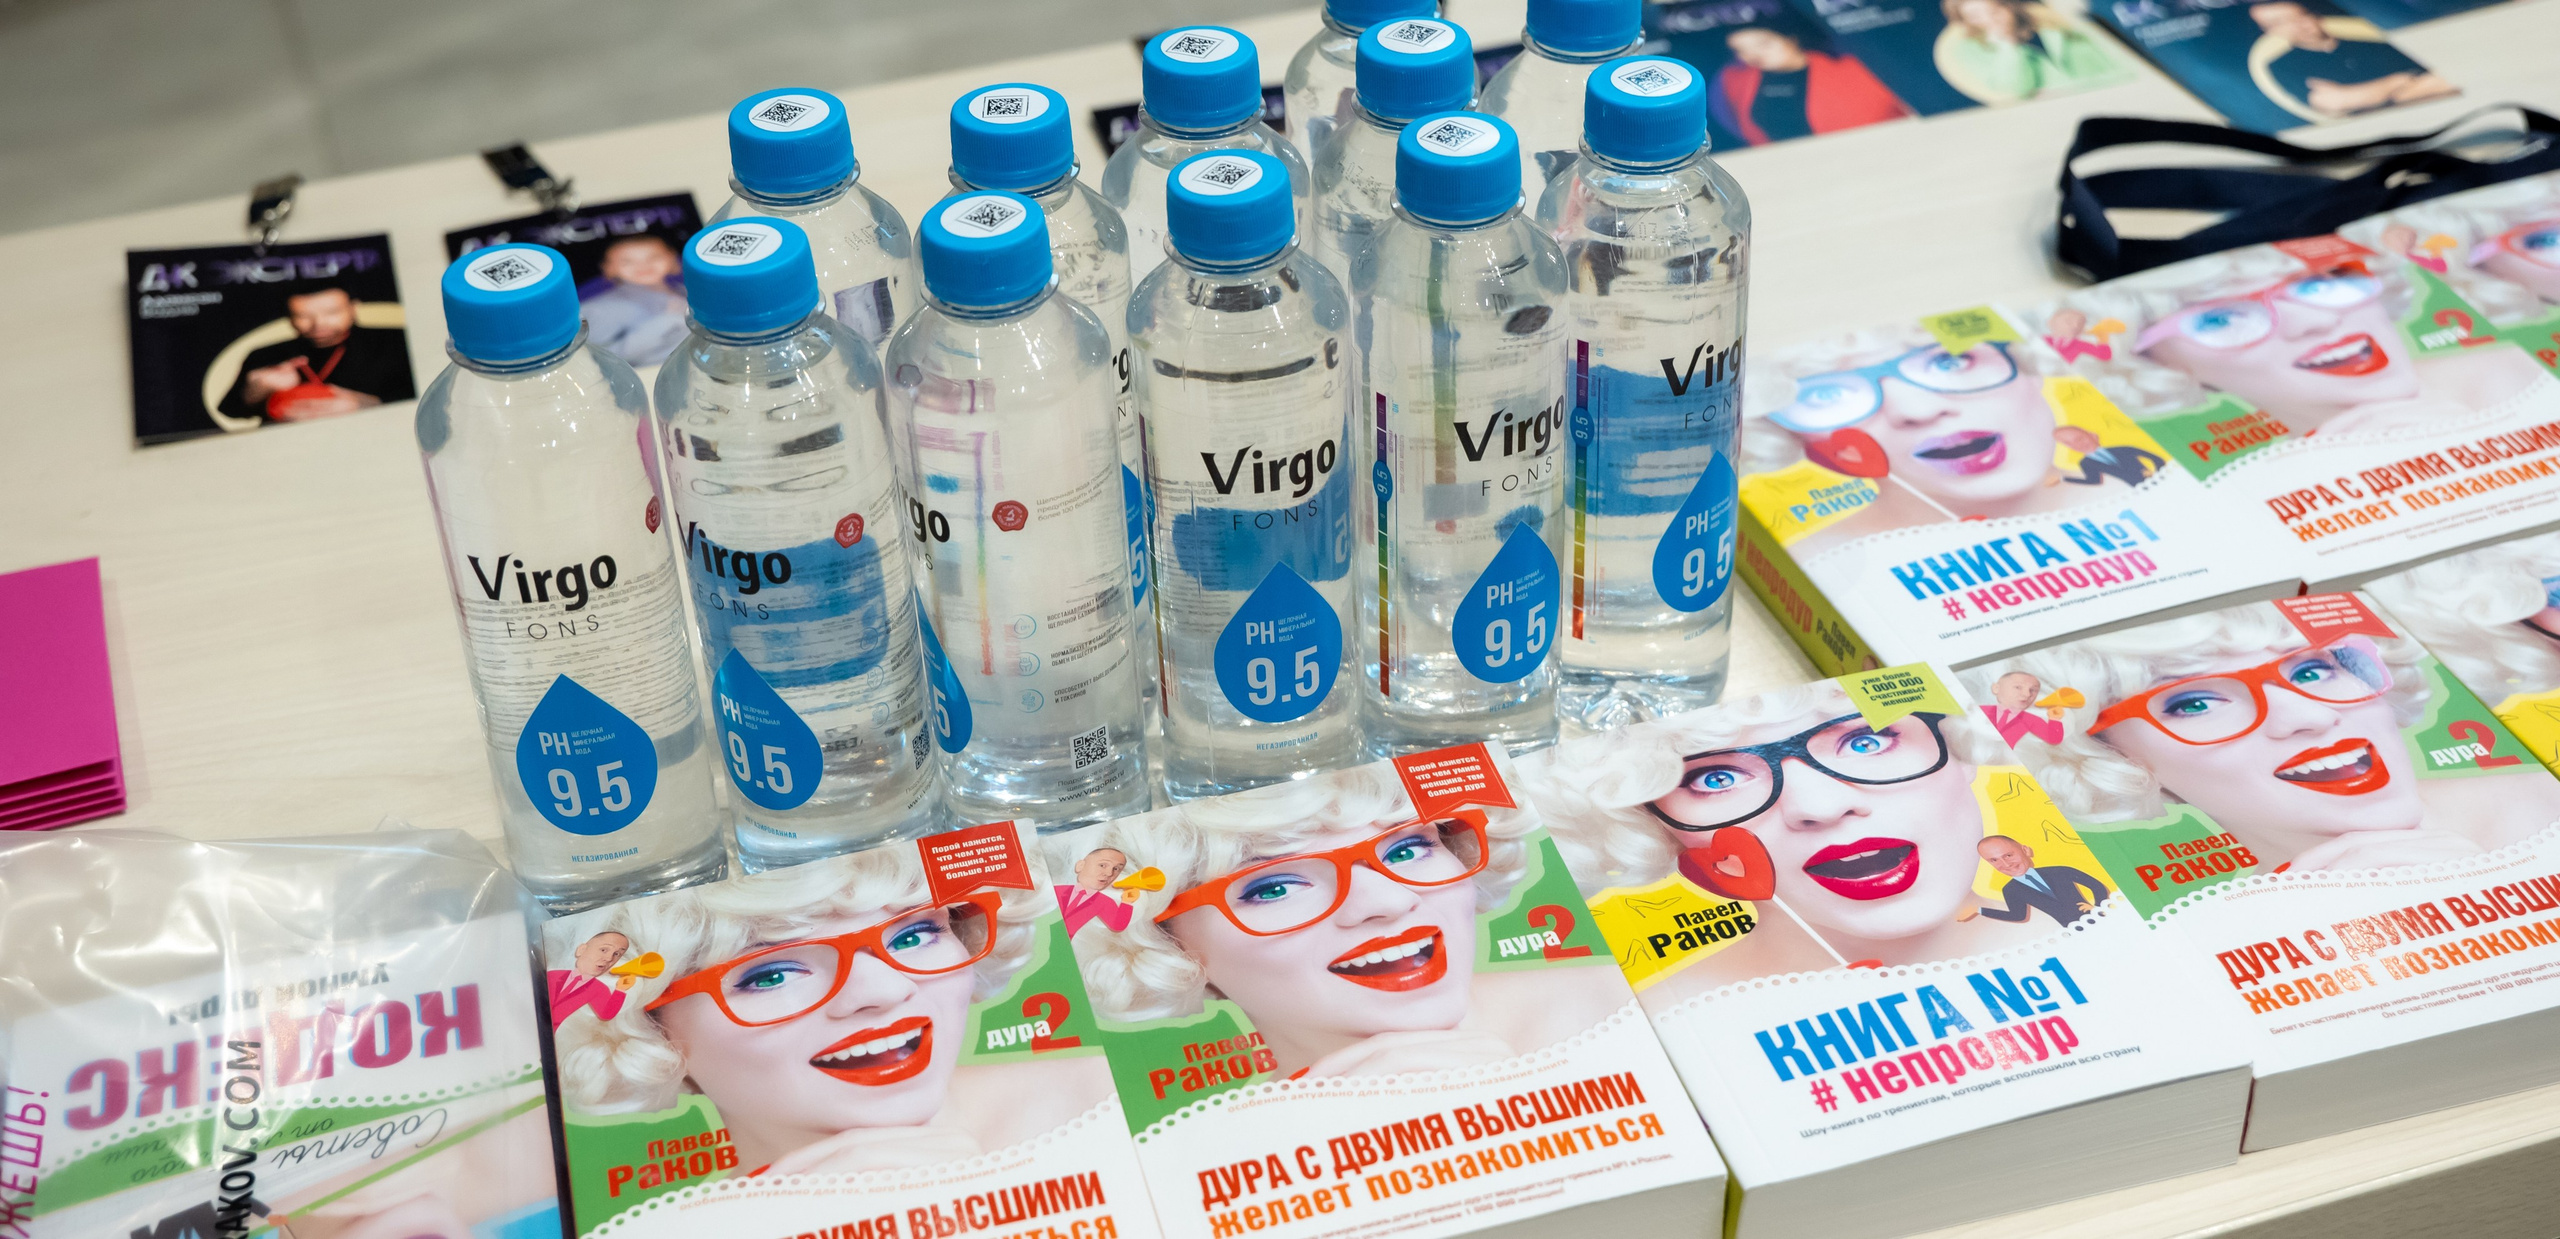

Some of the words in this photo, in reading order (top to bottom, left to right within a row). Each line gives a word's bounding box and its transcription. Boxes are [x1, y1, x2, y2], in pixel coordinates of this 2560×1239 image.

[2433, 309, 2497, 348] 2
[1453, 395, 1564, 462] Virgo
[1575, 415, 1589, 440] 9.5
[2188, 419, 2290, 462] Раков
[1200, 439, 1336, 499] Virgo
[1376, 468, 1388, 495] 9.5
[1482, 456, 1552, 497] FONS
[1789, 487, 1878, 522] Раков
[1808, 478, 1866, 500] Павел
[2264, 483, 2345, 525] ДУРА
[2334, 477, 2364, 499] С
[2357, 451, 2456, 499] ДВУМЯ
[1233, 500, 1318, 531] FONS
[1685, 510, 1709, 539] PH
[2291, 499, 2400, 543] желает
[675, 511, 792, 595] Virgo
[1682, 526, 1732, 597] 9.5
[1889, 531, 2070, 601] КНИГА
[2059, 508, 2161, 557] №1
[467, 553, 617, 611] Virgo
[1486, 580, 1513, 609] PH
[1966, 549, 2158, 614] непродур
[696, 582, 770, 620] FONS
[1277, 612, 1308, 625] ЩЕЛОЧНАЯ
[506, 613, 600, 640] FONS
[1245, 620, 1276, 645] PH
[1278, 617, 1316, 634] МИНЕРАЛЬНАЯ
[1278, 634, 1294, 643] ВОДА
[1485, 600, 1546, 668] 9.5
[1246, 645, 1320, 706] 9.5
[1869, 686, 1927, 701] счастливых
[1871, 681, 1898, 693] 000
[1898, 676, 1924, 688] 000
[720, 692, 743, 725] PH
[538, 731, 572, 756] PH
[571, 726, 604, 738] ЩЕЛОЧНАЯ
[572, 732, 616, 746] МИНЕРАЛЬНАЯ
[1256, 731, 1319, 751] НЕГАЗИРОВАННАЯ
[2447, 719, 2523, 770] 2
[574, 747, 592, 755] ВОДА
[727, 730, 794, 795] 9.5
[1408, 762, 1437, 773] Порой
[2430, 741, 2490, 767] дура
[547, 759, 632, 818] 9.5
[1058, 769, 1125, 802] www.VirgoPro.ru
[1432, 770, 1452, 778] чем
[1452, 764, 1482, 775] умнее
[1466, 773, 1485, 782] тем
[1427, 786, 1463, 798] больше
[1464, 781, 1487, 792] дура
[571, 846, 639, 863] НЕГАЗИРОВАННАЯ
[931, 842, 961, 854] Порой
[954, 851, 975, 860] чем
[975, 844, 1006, 857] умнее
[989, 853, 1008, 862] тем
[2160, 831, 2242, 862] Павел
[945, 868, 983, 880] больше
[984, 862, 1007, 873] дура
[2134, 845, 2260, 892] Раков
[2223, 885, 2278, 902] особенно
[2281, 880, 2342, 891] актуально
[2345, 880, 2368, 890] для
[2395, 877, 2422, 887] кого
[2424, 872, 2456, 884] бесит
[2457, 863, 2508, 880] название
[2509, 853, 2538, 868] книги
[1672, 900, 1744, 929] Павел
[1498, 928, 1561, 959] дура
[1526, 904, 1594, 962] 2
[1647, 913, 1757, 959] Раков
[2215, 936, 2314, 990] ДУРА
[2302, 929, 2338, 962] С
[2330, 902, 2456, 961] ДВУМЯ
[2241, 963, 2379, 1015] желает
[2457, 988, 2486, 1000] более
[986, 1019, 1052, 1050] дура
[1021, 992, 1082, 1054] 2
[1754, 984, 1974, 1082] КНИГА
[1964, 956, 2090, 1021] №1
[1182, 1029, 1267, 1064] Павел
[1809, 1078, 1839, 1113] #
[1840, 1015, 2079, 1104] непродур
[1148, 1045, 1278, 1099] Раков
[1357, 1088, 1380, 1098] для
[1440, 1080, 1476, 1092] бесит
[1478, 1069, 1535, 1087] название
[1537, 1057, 1569, 1076] книги
[1799, 1115, 1866, 1139] Шоу-книга
[1866, 1110, 1882, 1121] по
[1883, 1093, 1951, 1117] тренингам,
[1951, 1078, 2002, 1098] которые
[2003, 1060, 2077, 1084] всполошили
[2078, 1053, 2102, 1066] всю
[2103, 1044, 2142, 1063] страну
[214, 1039, 262, 1239] AKOV.COM
[272, 1108, 449, 1172] Советы
[646, 1127, 732, 1160] Павел
[1196, 1151, 1294, 1211] ДУРА
[1295, 1145, 1322, 1180] С
[1327, 1112, 1455, 1179] ДВУМЯ
[1453, 1071, 1647, 1142] ВЫСШИМИ
[0, 1085, 50, 1239] ЖЕШЬ!
[607, 1144, 740, 1198] Раков
[1209, 1182, 1353, 1239] желает
[1365, 1112, 1666, 1201] познакомиться
[906, 1170, 1107, 1239] ВЫСШИМИ
